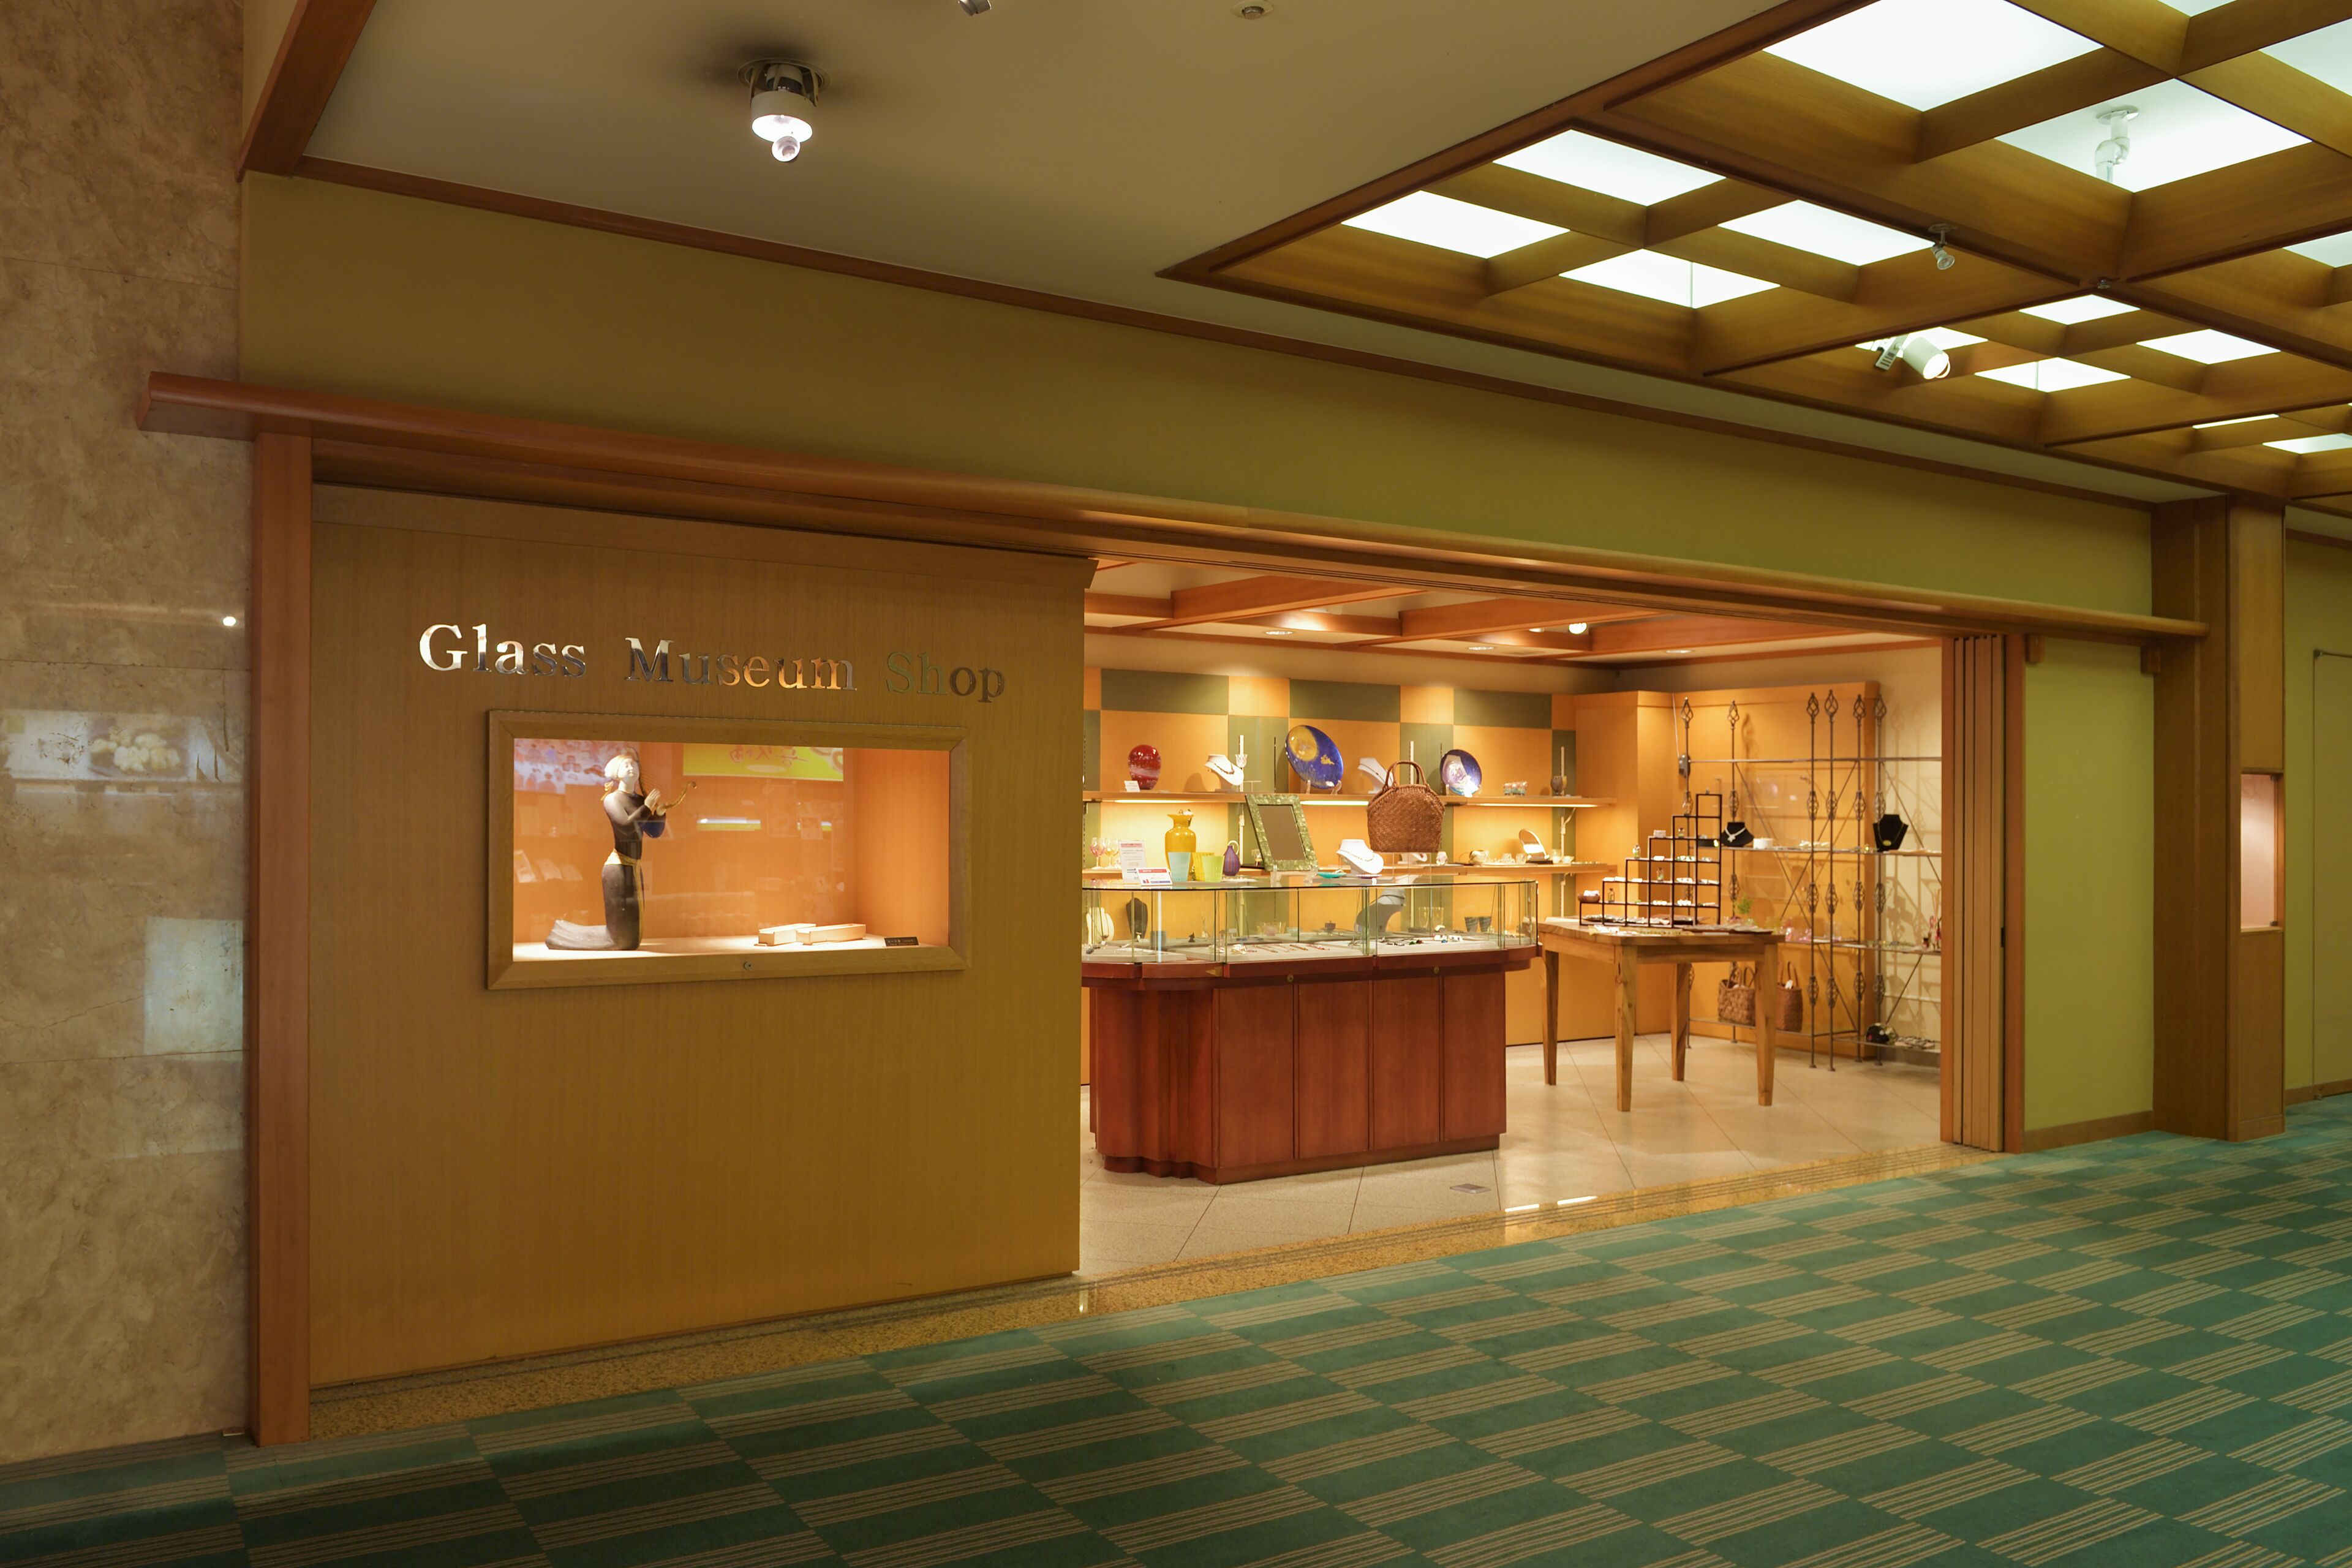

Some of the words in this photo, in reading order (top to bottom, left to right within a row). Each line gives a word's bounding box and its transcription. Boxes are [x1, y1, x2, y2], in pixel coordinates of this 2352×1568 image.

[420, 624, 586, 677] Glass
[624, 638, 858, 691] Museum
[886, 651, 1005, 703] Shop
